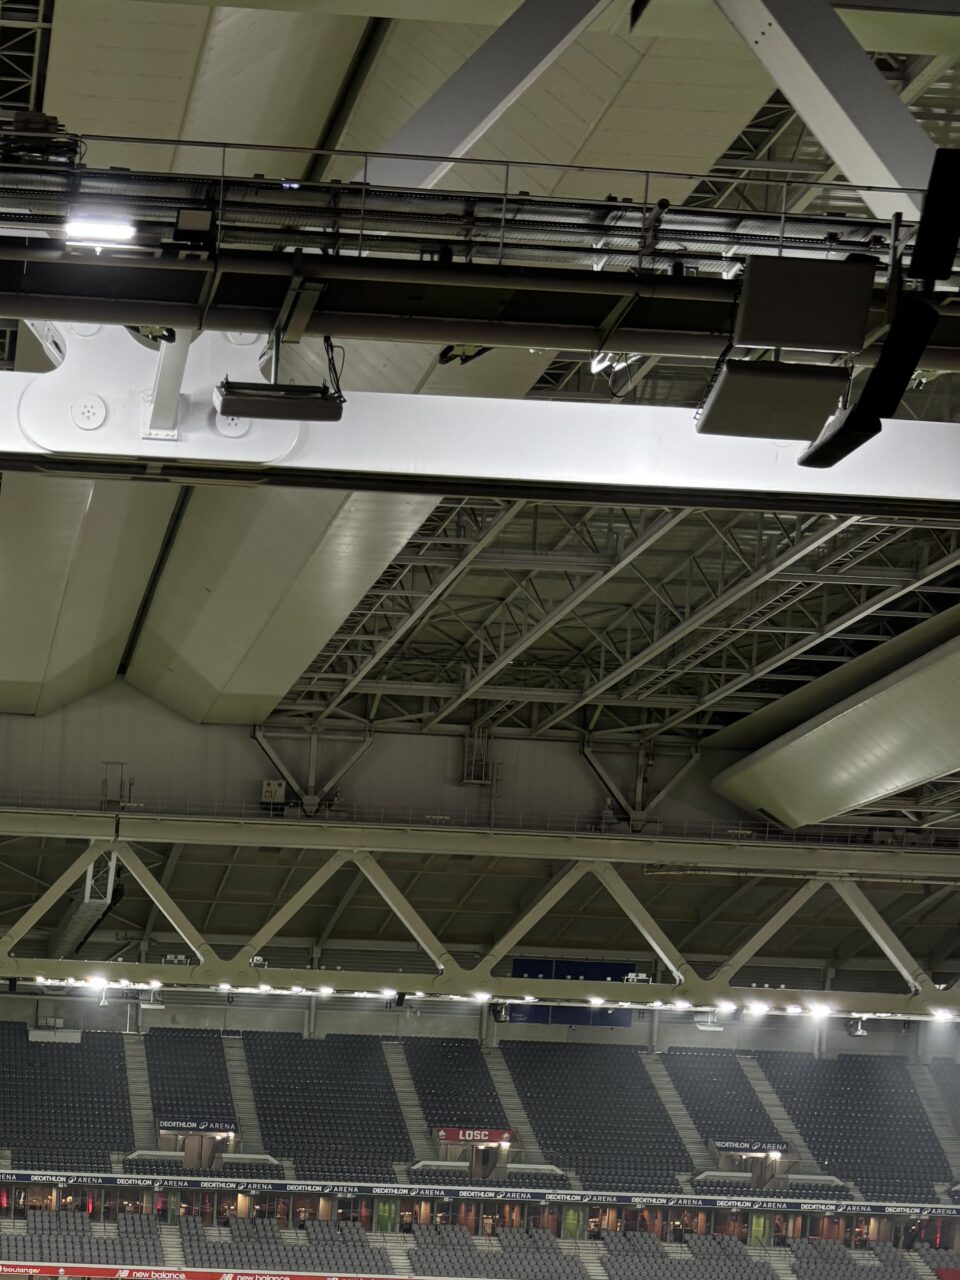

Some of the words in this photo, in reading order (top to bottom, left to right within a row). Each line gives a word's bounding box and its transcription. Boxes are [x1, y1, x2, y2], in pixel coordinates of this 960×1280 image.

[459, 1131, 488, 1140] LOSC
[31, 1174, 66, 1182] DECATHLON
[78, 1176, 102, 1184] ARENA
[117, 1177, 152, 1186] DECATHLON
[164, 1179, 188, 1187] ARENA
[201, 1181, 235, 1189] DECATHLON
[287, 1184, 321, 1192] DECATHLON
[373, 1187, 408, 1195] DECATHLON
[420, 1189, 444, 1197] ARENA
[460, 1190, 495, 1198] DECATHLON
[546, 1193, 581, 1201] DECATHLON
[632, 1196, 666, 1204] DECATHLON
[717, 1200, 751, 1208] DECATHLON
[801, 1203, 836, 1211] DECATHLON
[885, 1206, 920, 1214] DECATHLON
[3, 1266, 40, 1274] boulanger
[151, 1270, 185, 1280] balance
